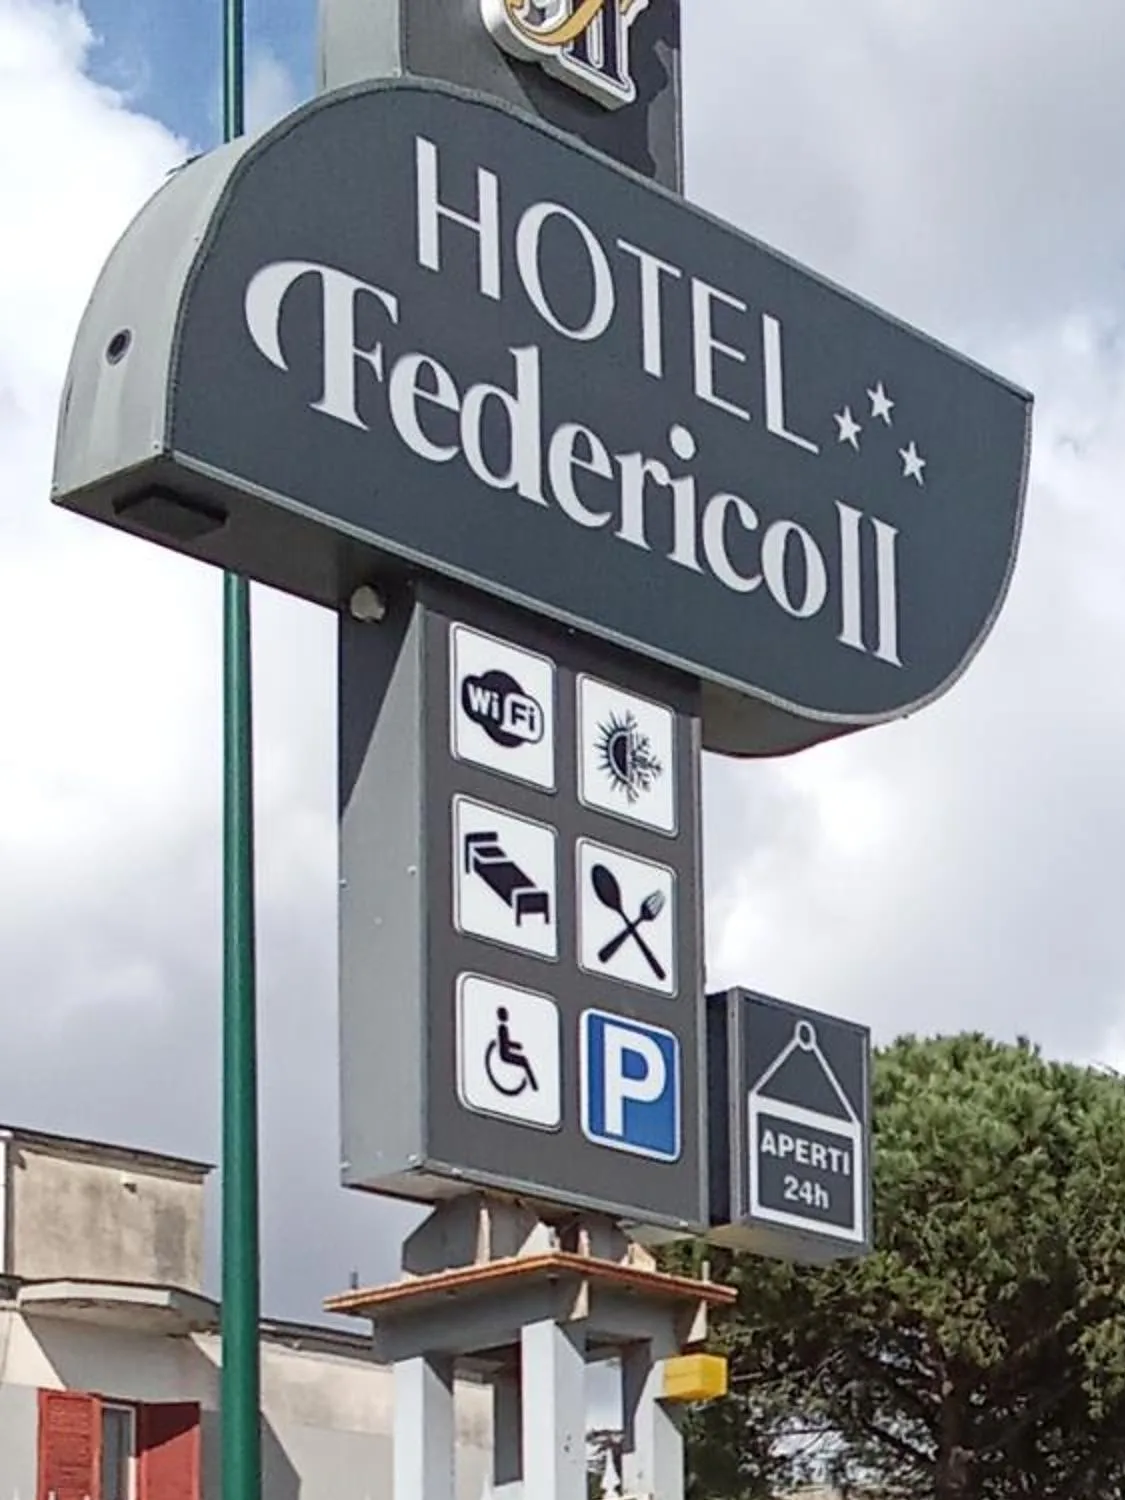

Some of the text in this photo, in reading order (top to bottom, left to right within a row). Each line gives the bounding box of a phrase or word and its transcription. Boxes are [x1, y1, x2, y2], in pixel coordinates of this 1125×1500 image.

[415, 135, 820, 455] HOTEL
[602, 1022, 666, 1137] P
[761, 1128, 850, 1176] APERTI
[783, 1174, 829, 1209] 24h
